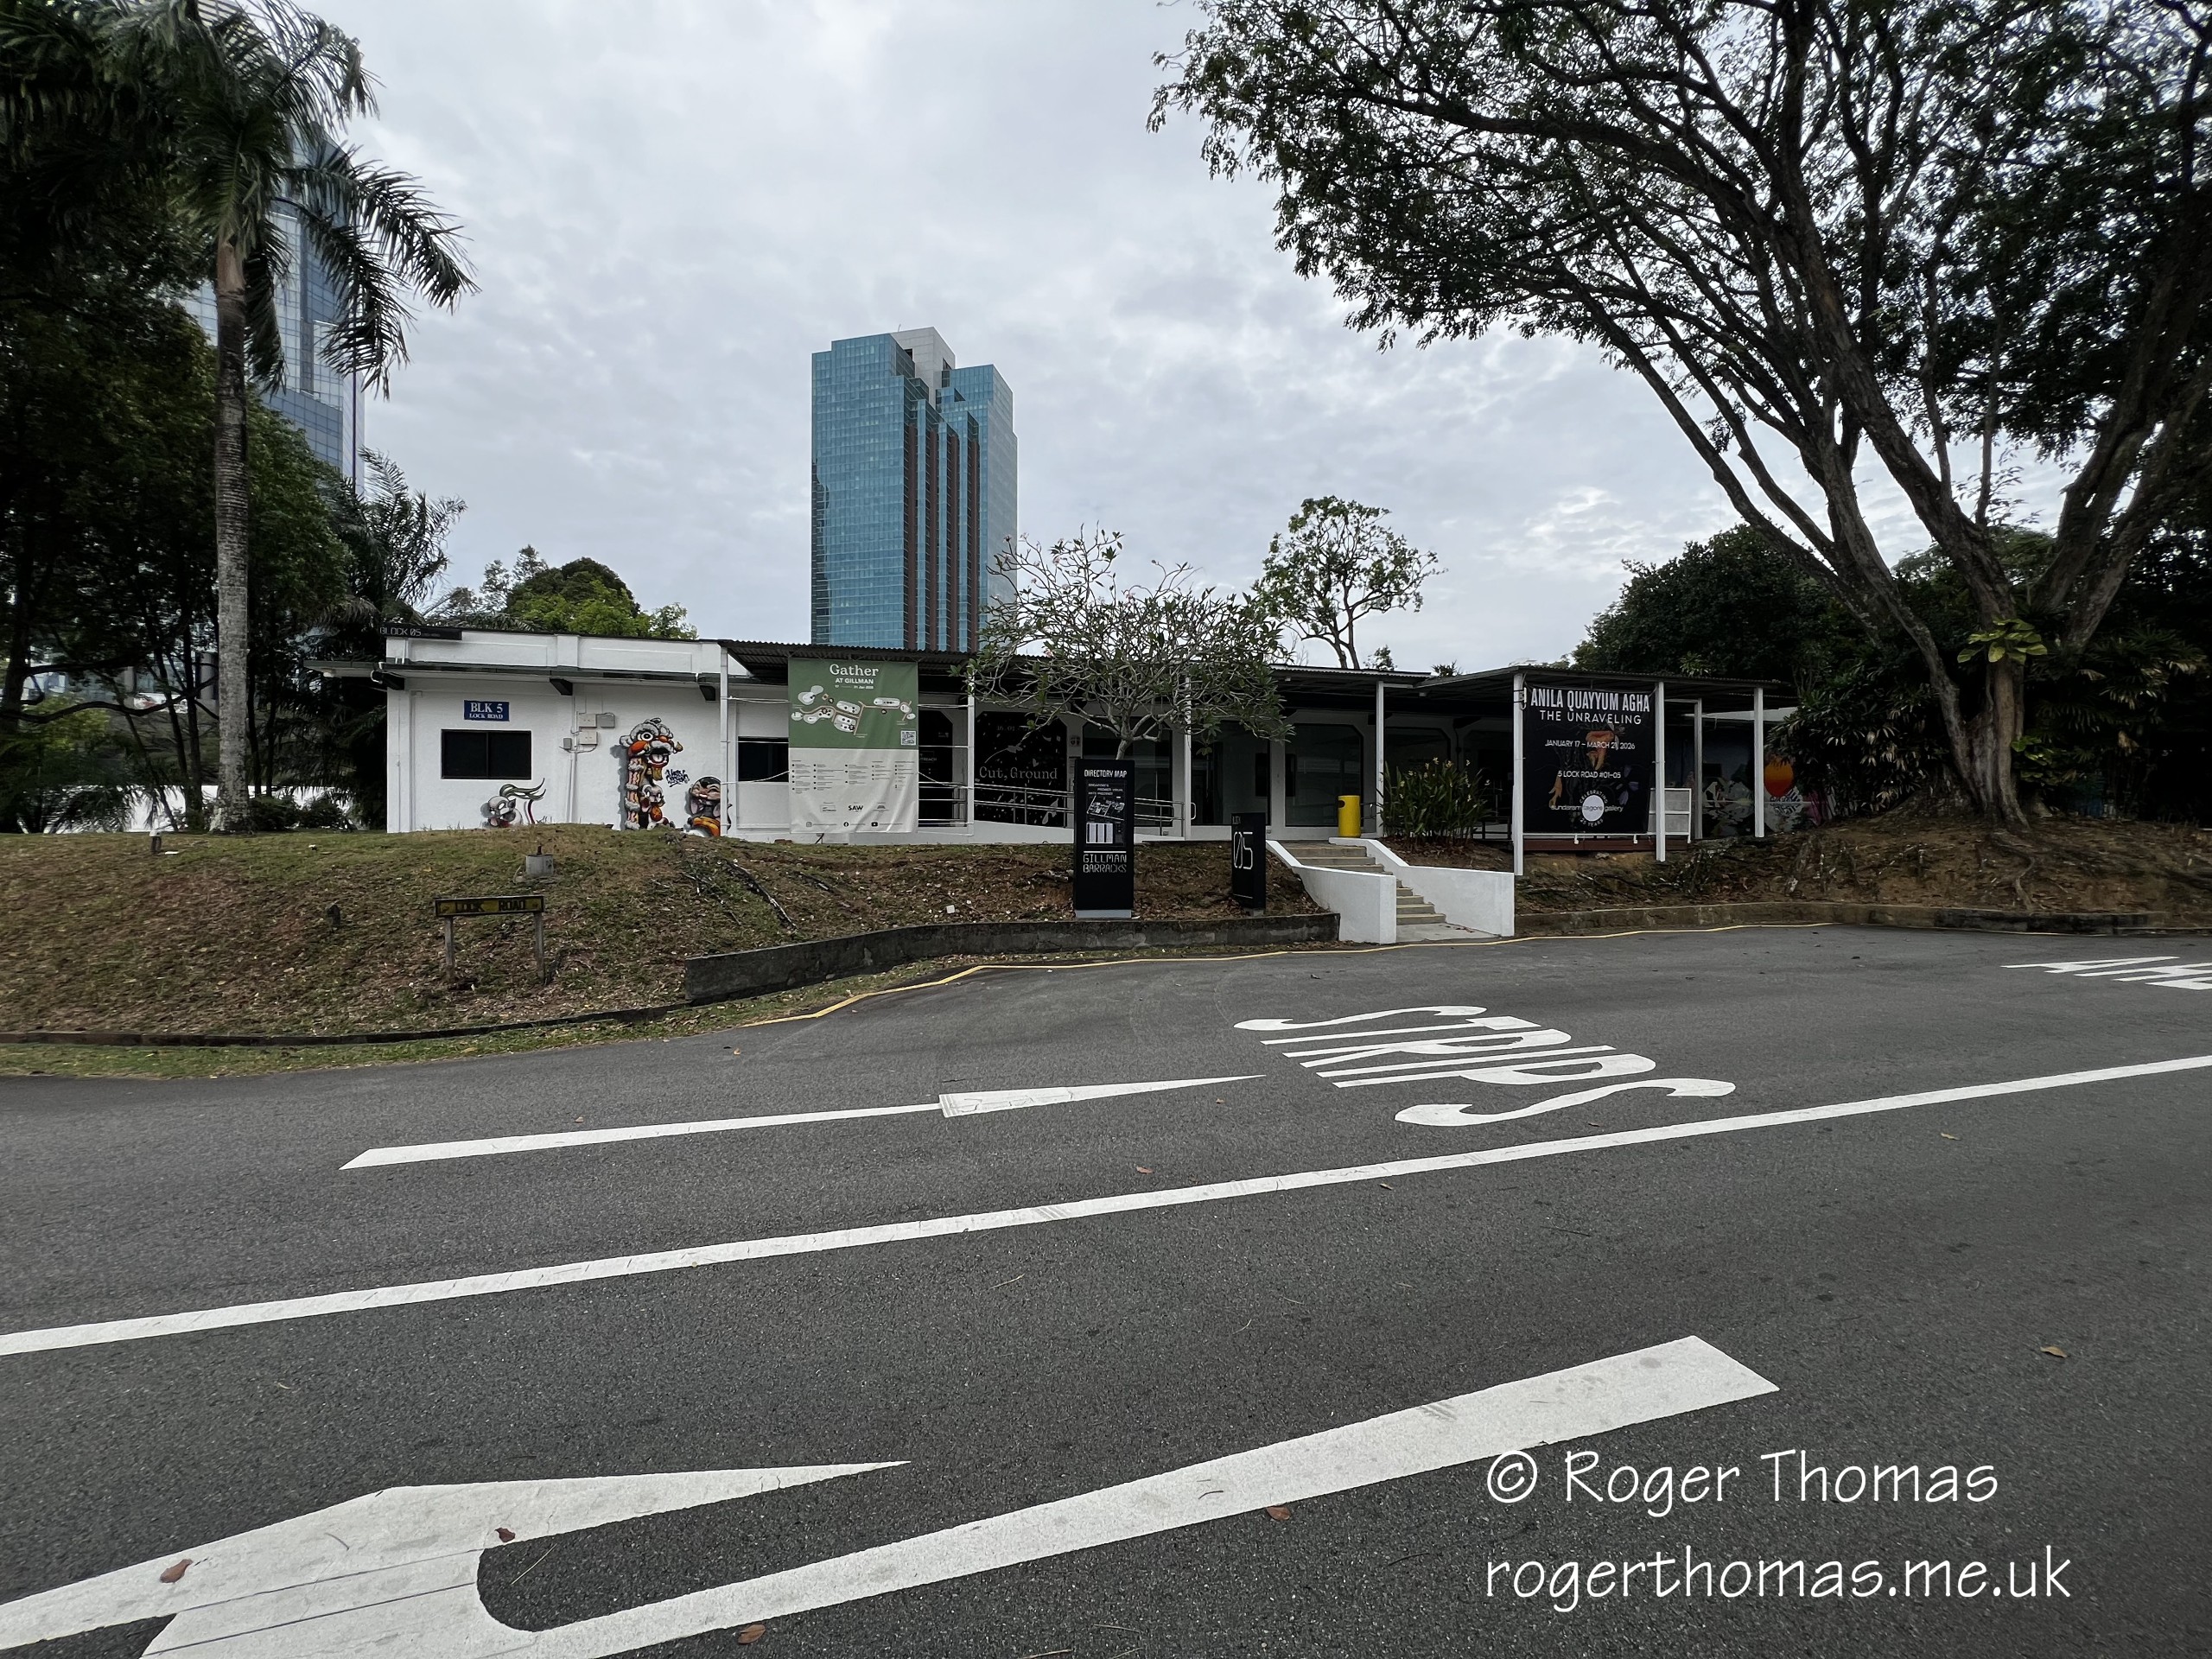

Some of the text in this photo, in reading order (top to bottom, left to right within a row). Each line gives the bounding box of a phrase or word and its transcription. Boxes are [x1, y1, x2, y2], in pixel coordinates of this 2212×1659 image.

[379, 626, 408, 636] BLOCK
[410, 628, 422, 637] 05
[830, 664, 879, 677] Gather
[1530, 688, 1649, 712] ANILA QUAYYUM AGHA
[470, 702, 503, 714] BLK 5
[1539, 709, 1642, 725] THE UNRAVELING
[1545, 739, 1574, 747] JANUARY
[1586, 741, 1610, 749] MARCH
[1619, 741, 1636, 750] 2026
[979, 766, 1007, 780] Cut,
[1010, 766, 1058, 779] Ground
[1084, 769, 1114, 778] DIRECTORY
[1114, 770, 1128, 779] MAP
[1579, 789, 1608, 804] CELEBRATING
[1233, 831, 1253, 870] 05
[1083, 854, 1127, 863] GILLMAN
[1083, 863, 1127, 874] BARRACKS
[1232, 1005, 1737, 1127] STRIPS
